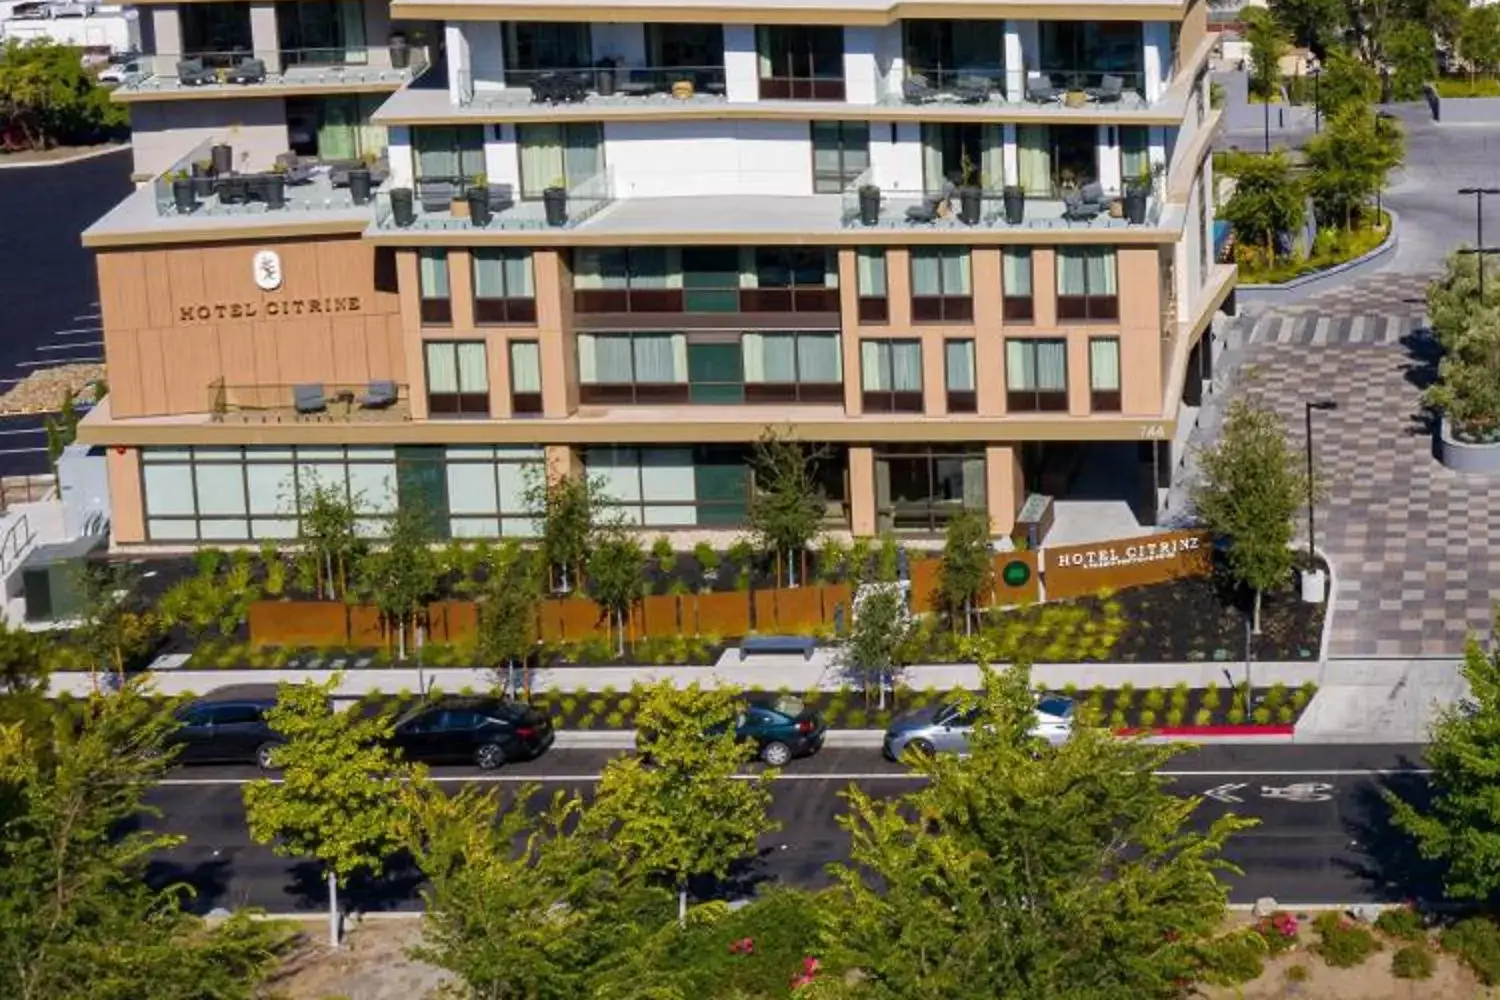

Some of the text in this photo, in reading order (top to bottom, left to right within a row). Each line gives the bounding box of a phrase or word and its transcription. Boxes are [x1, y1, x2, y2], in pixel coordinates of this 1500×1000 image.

[179, 297, 361, 321] HOTEL CITRINE
[1057, 547, 1119, 567] HOTEL
